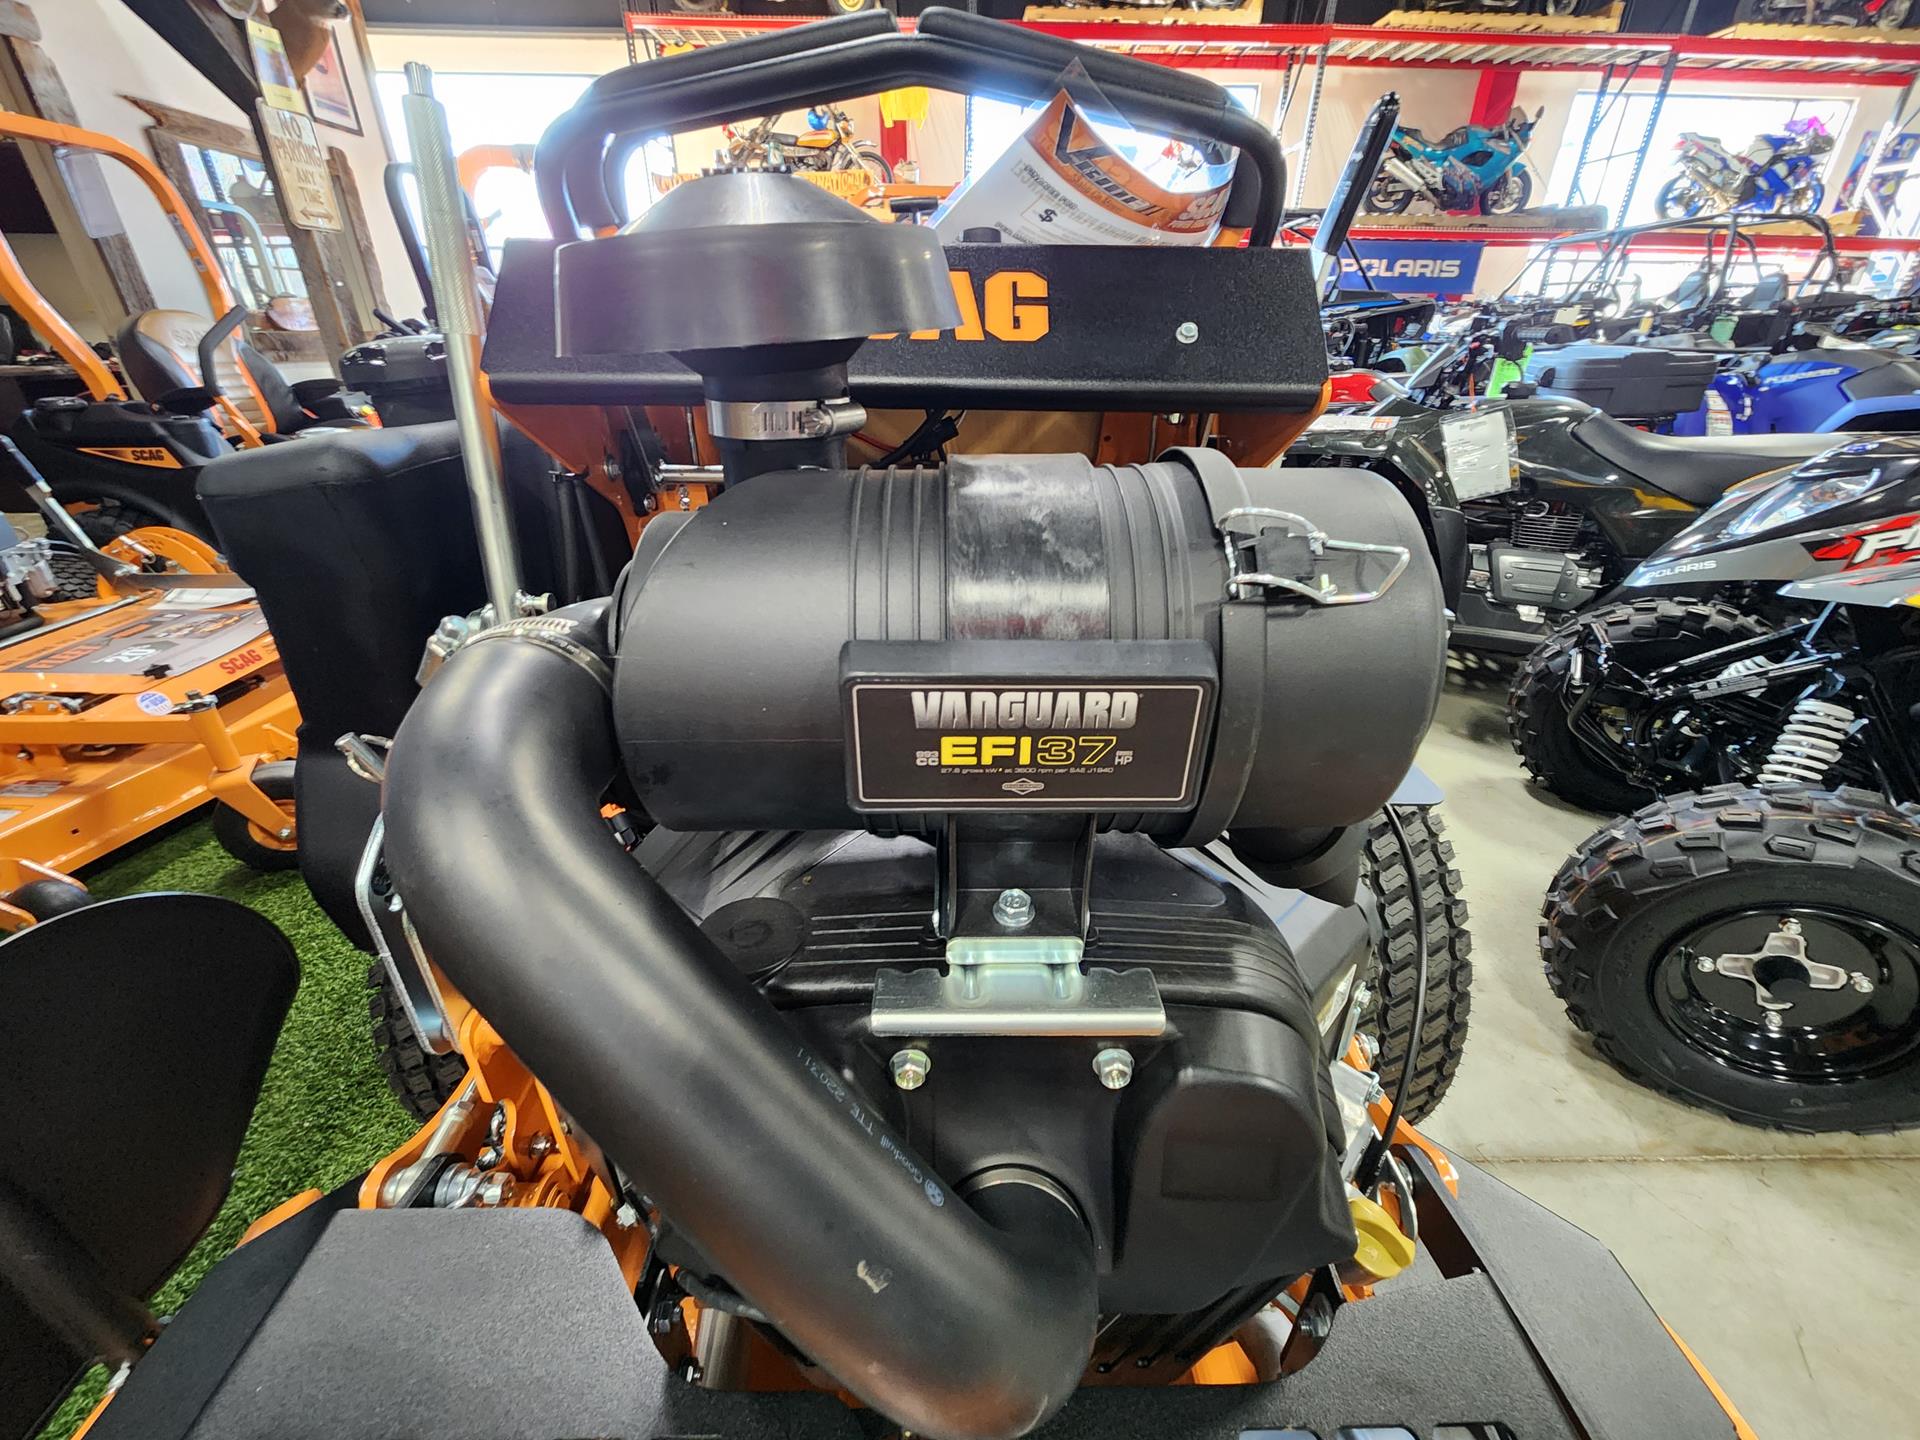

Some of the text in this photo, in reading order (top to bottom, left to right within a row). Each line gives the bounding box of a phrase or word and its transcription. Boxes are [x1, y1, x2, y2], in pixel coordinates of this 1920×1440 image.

[276, 110, 303, 139] NO
[271, 137, 324, 168] PARKING
[296, 166, 317, 186] ANY
[1038, 208, 1058, 223] $
[1341, 258, 1462, 278] POLARIS
[131, 449, 165, 462] SCAG
[1647, 559, 1717, 578] POLARIS
[219, 649, 263, 675] SCAG
[911, 691, 1139, 729] VANGUARD
[916, 757, 939, 766] CC
[1114, 755, 1133, 766] HP
